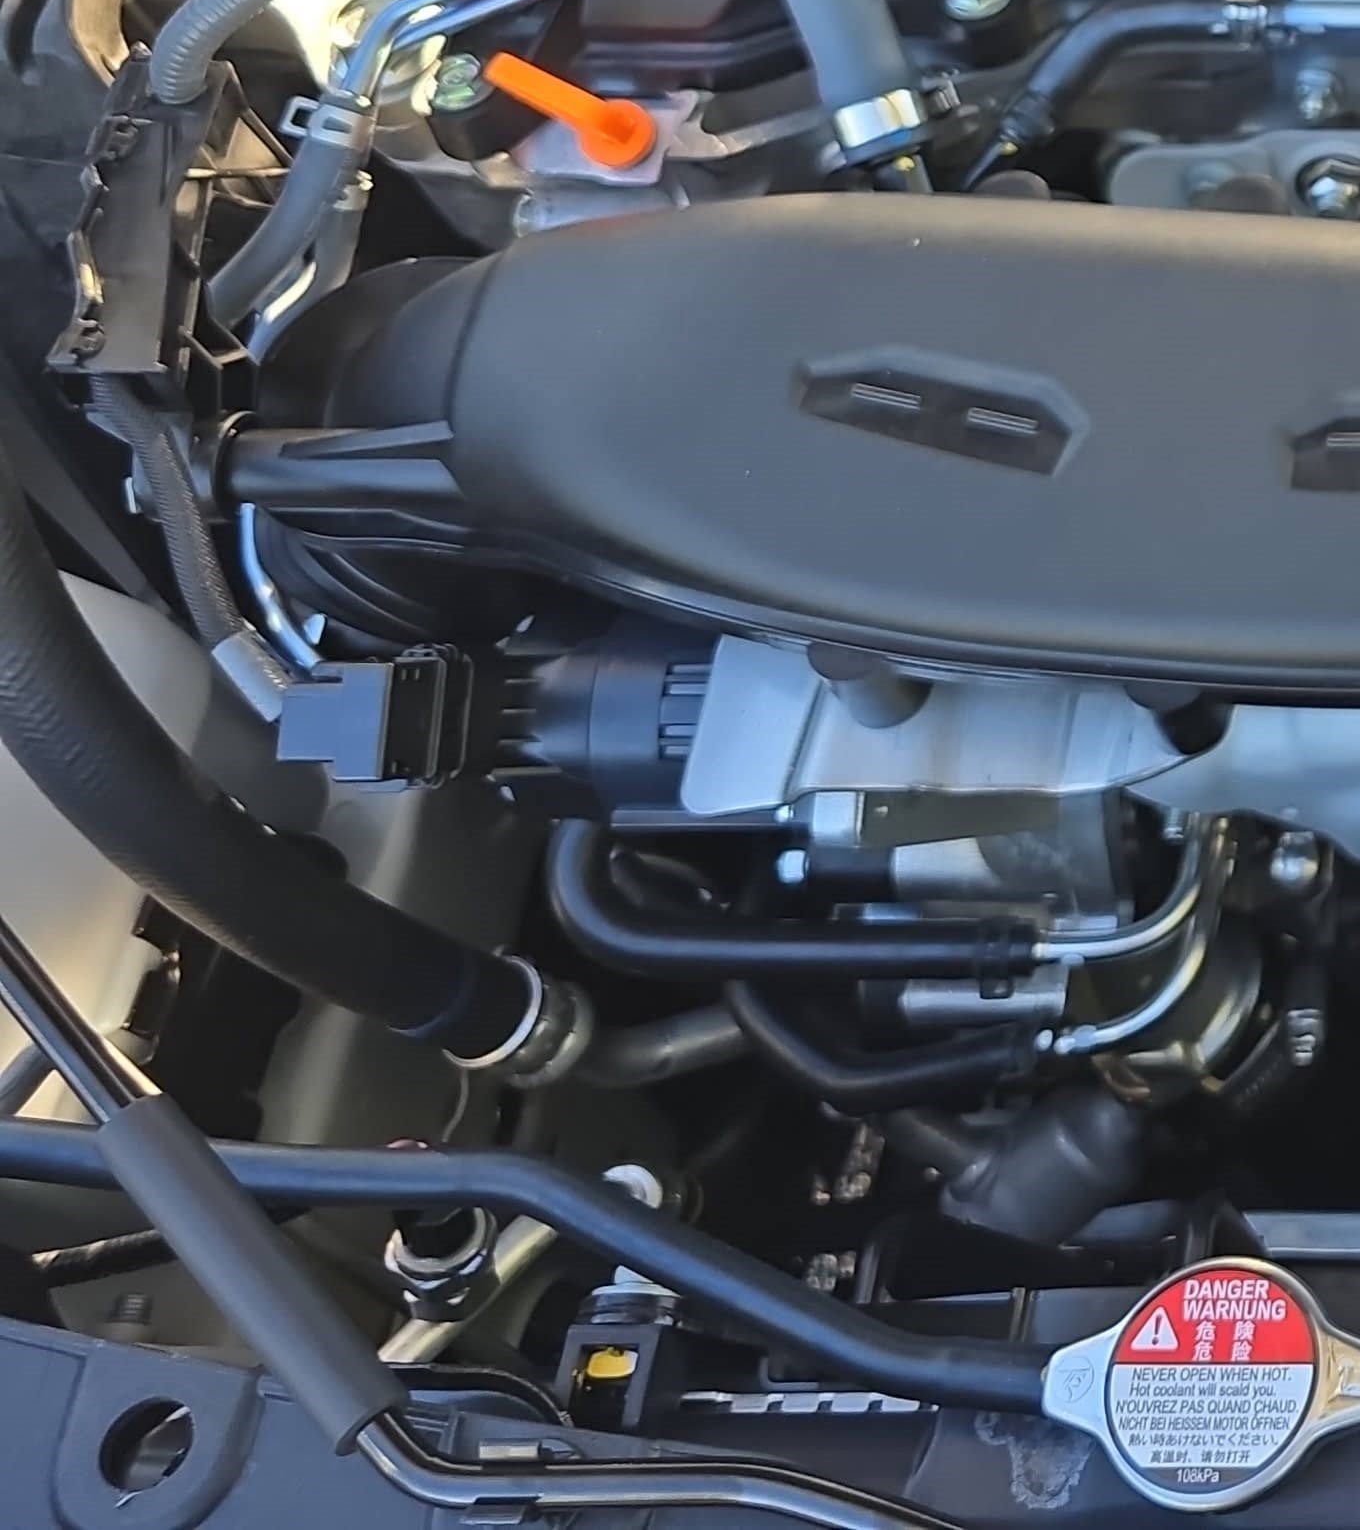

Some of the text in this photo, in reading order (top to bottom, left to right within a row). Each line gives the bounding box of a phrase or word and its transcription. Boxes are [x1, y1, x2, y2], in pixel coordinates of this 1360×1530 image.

[1184, 1279, 1270, 1299] DANGER
[1183, 1300, 1287, 1320] WARNUNG
[1132, 1367, 1292, 1382] NEVER OPEN WHEN HOT.
[1129, 1382, 1277, 1400] Hot coolant will scald you.
[1115, 1399, 1299, 1414] N'OUVREZ PAS QUAND CHAUD.
[1119, 1416, 1149, 1430] NICHT
[1150, 1416, 1167, 1430] BEI
[1168, 1416, 1211, 1430] HEISSEM
[1213, 1416, 1249, 1430] MOTOR
[1176, 1468, 1220, 1483] 108kPa
